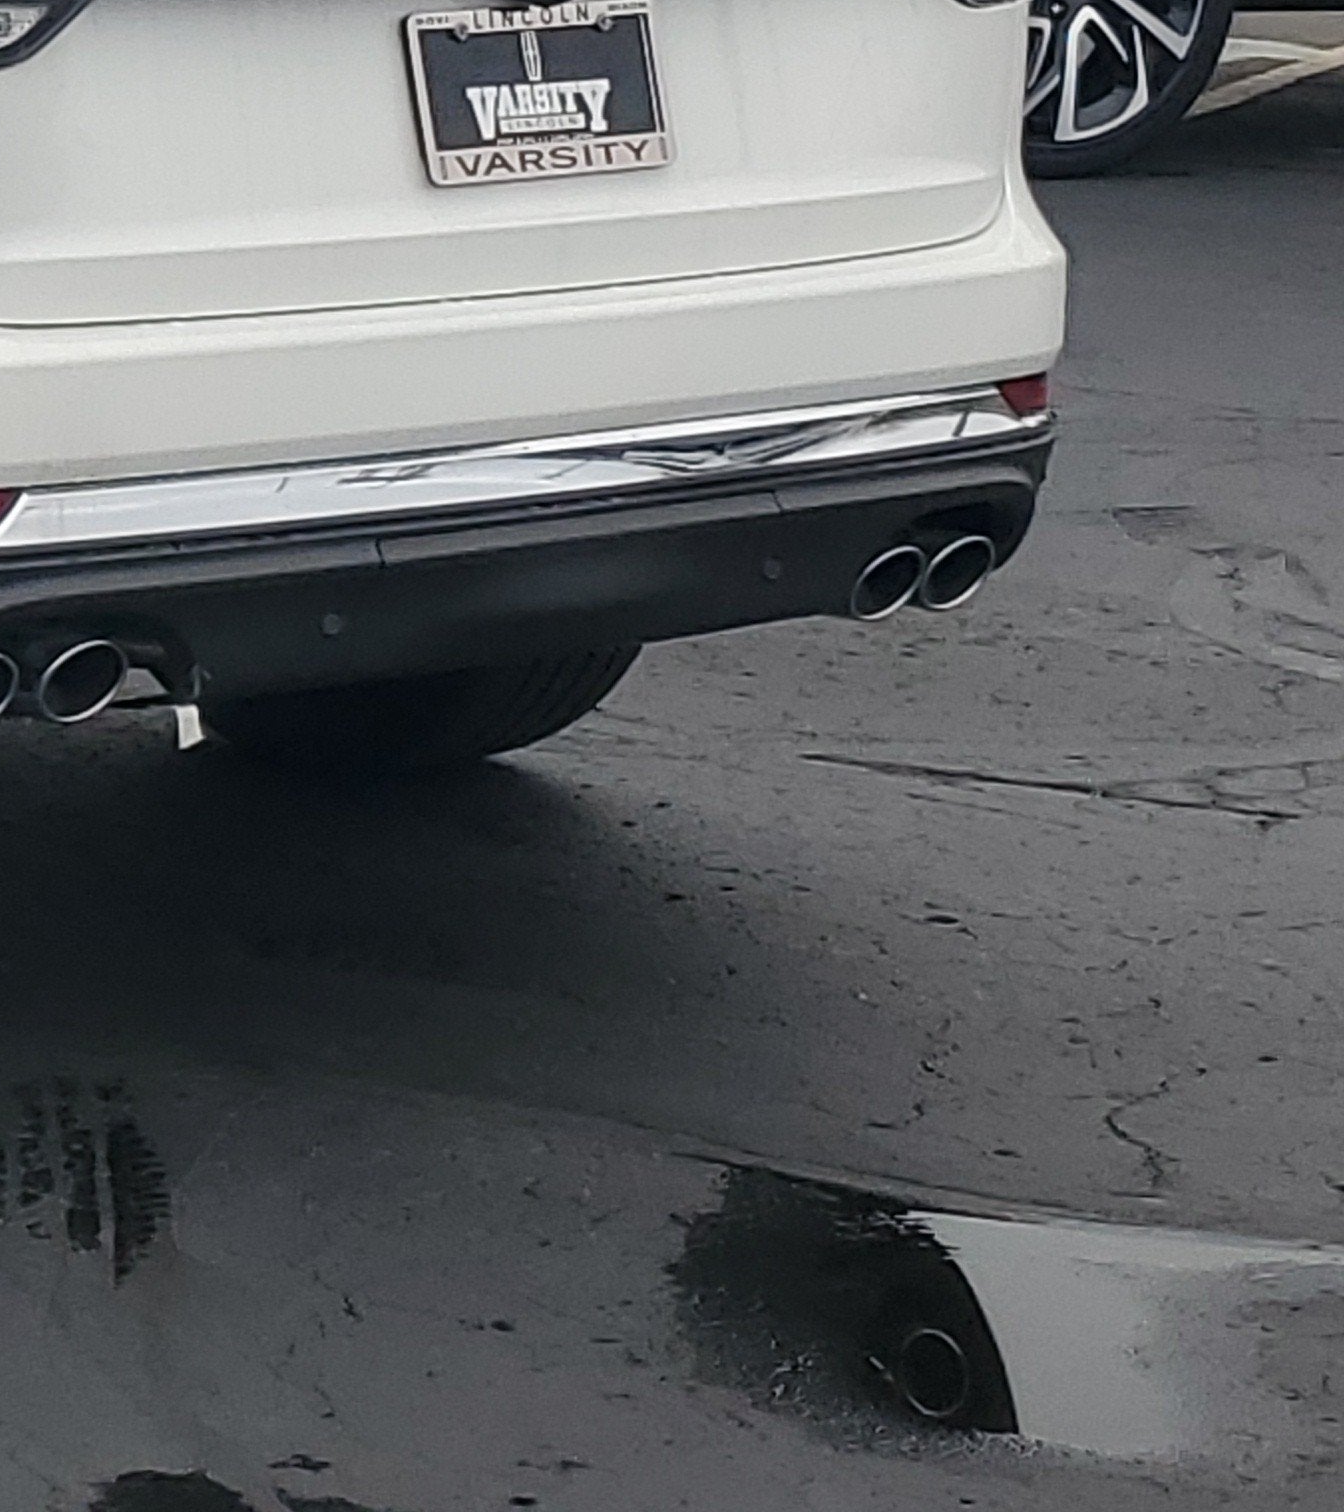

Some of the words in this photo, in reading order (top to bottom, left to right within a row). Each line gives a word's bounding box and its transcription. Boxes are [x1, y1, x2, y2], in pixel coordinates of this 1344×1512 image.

[472, 4, 590, 30] LINCOLN
[465, 78, 611, 141] VARSITY
[455, 140, 650, 177] VARSITY
